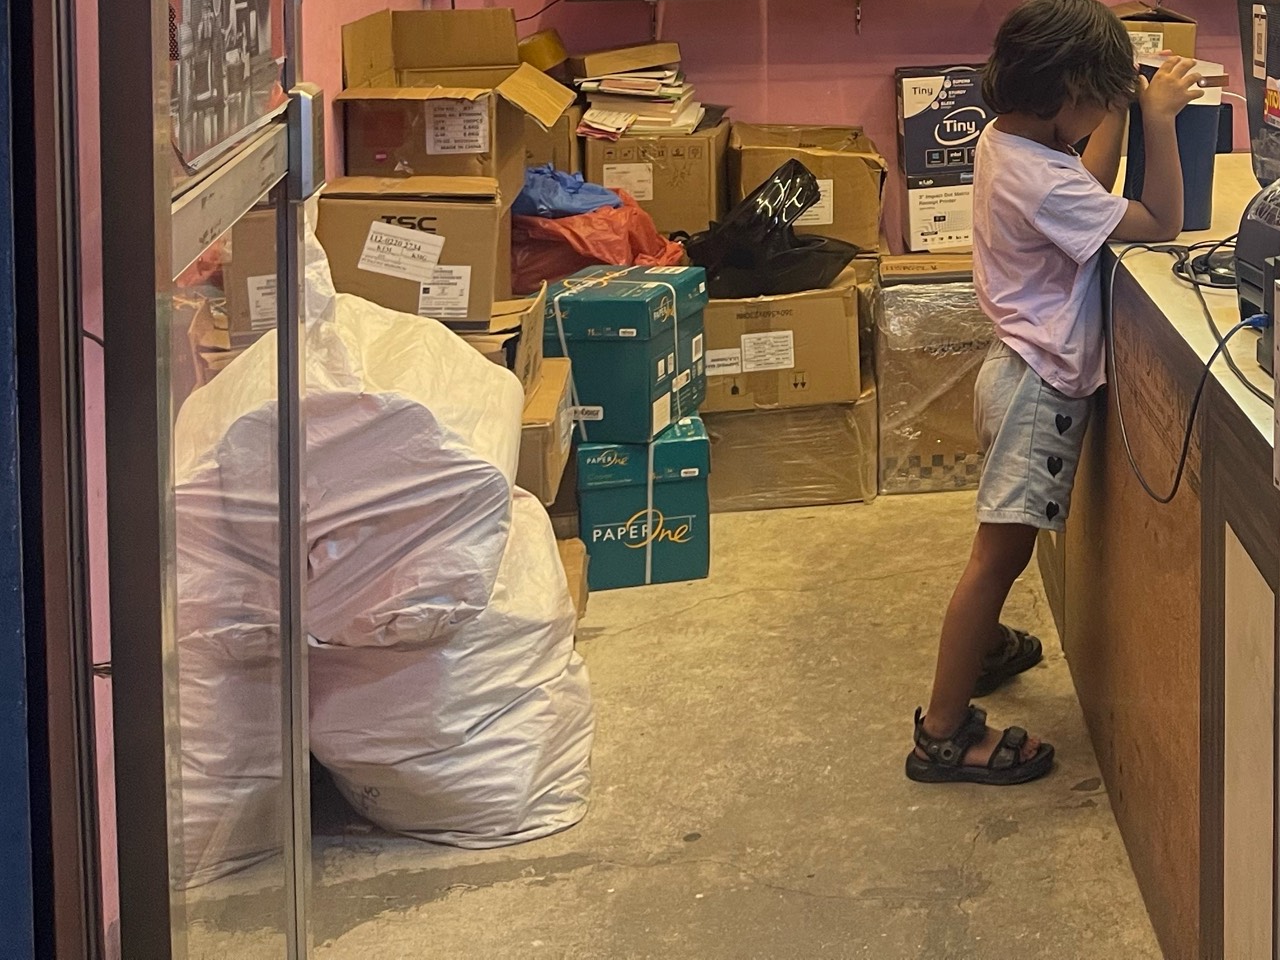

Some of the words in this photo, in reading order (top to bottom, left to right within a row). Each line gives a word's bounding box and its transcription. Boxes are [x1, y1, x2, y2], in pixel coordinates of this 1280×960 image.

[912, 87, 933, 96] Tiny
[943, 120, 976, 134] Tiny
[381, 215, 437, 231] TSC
